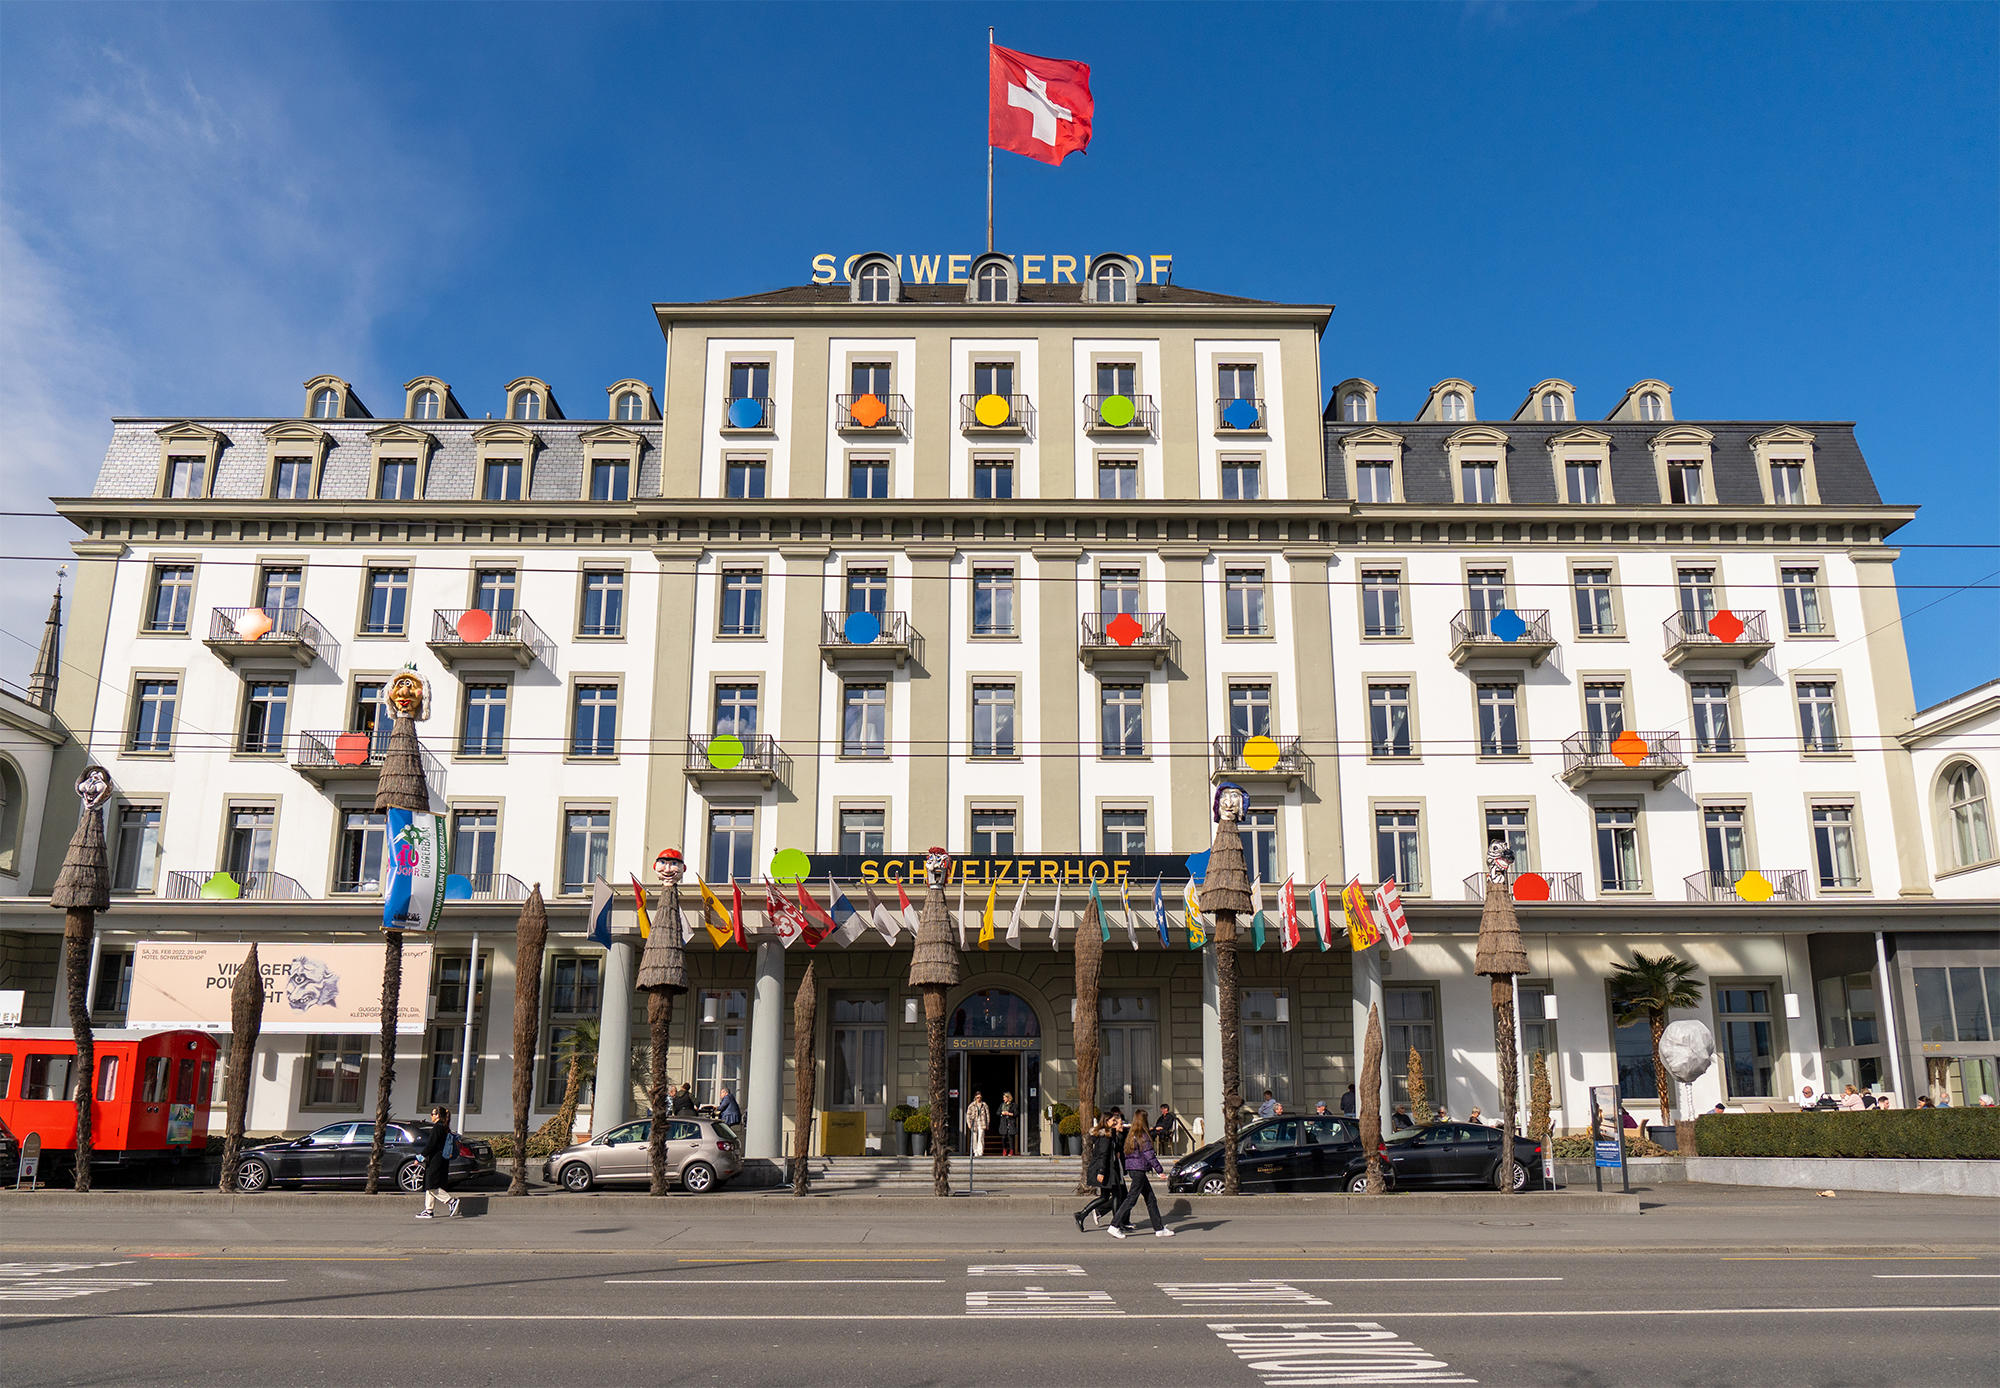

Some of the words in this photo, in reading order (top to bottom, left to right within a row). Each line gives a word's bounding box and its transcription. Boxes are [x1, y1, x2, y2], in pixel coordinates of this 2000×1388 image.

[395, 845, 419, 868] 40
[953, 1039, 1035, 1048] SCHWEIZERHOF
[1923, 1044, 1942, 1052] BAR
[1206, 1322, 1479, 1386] EBIKON
